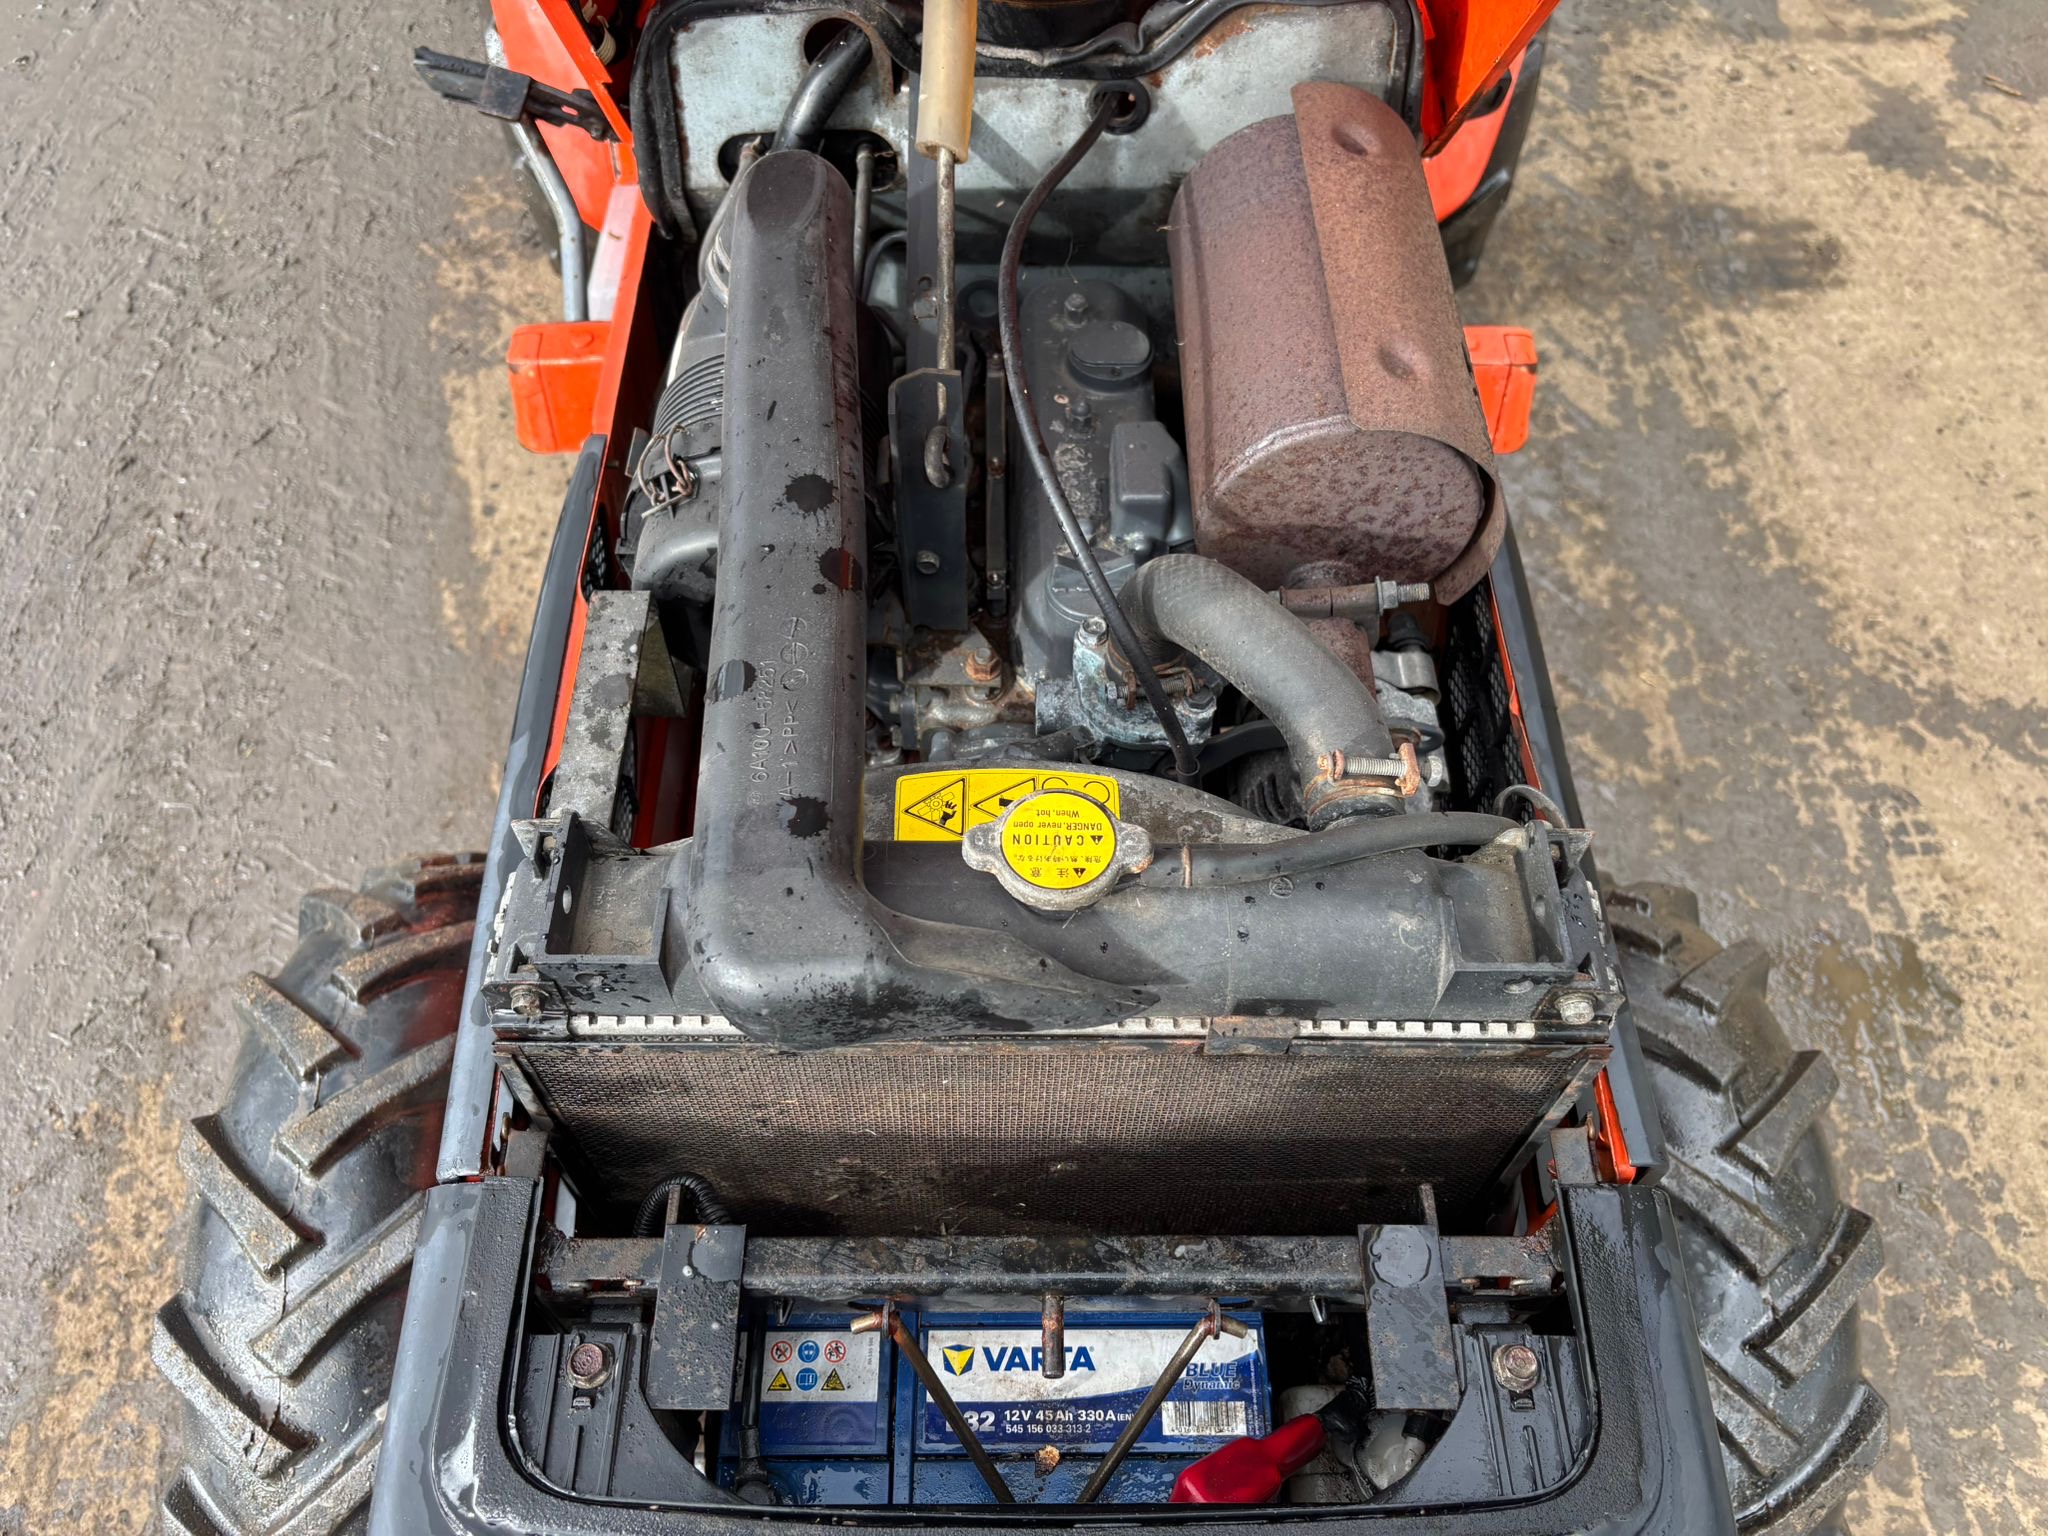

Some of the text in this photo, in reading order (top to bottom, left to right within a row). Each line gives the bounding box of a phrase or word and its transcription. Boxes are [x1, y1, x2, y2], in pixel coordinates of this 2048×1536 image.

[1036, 809, 1051, 818] hot
[1013, 820, 1034, 829] open
[1038, 821, 1062, 829] never
[1012, 834, 1085, 846] CAUTION
[1185, 1361, 1238, 1378] BLUE
[1183, 1378, 1241, 1393] Dynamic
[1004, 1409, 1032, 1421] 12V
[1035, 1409, 1073, 1421] 45Ah
[1005, 1424, 1024, 1434] 545
[1027, 1424, 1044, 1434] 156
[1046, 1424, 1063, 1434] 033
[1066, 1424, 1083, 1434] 313
